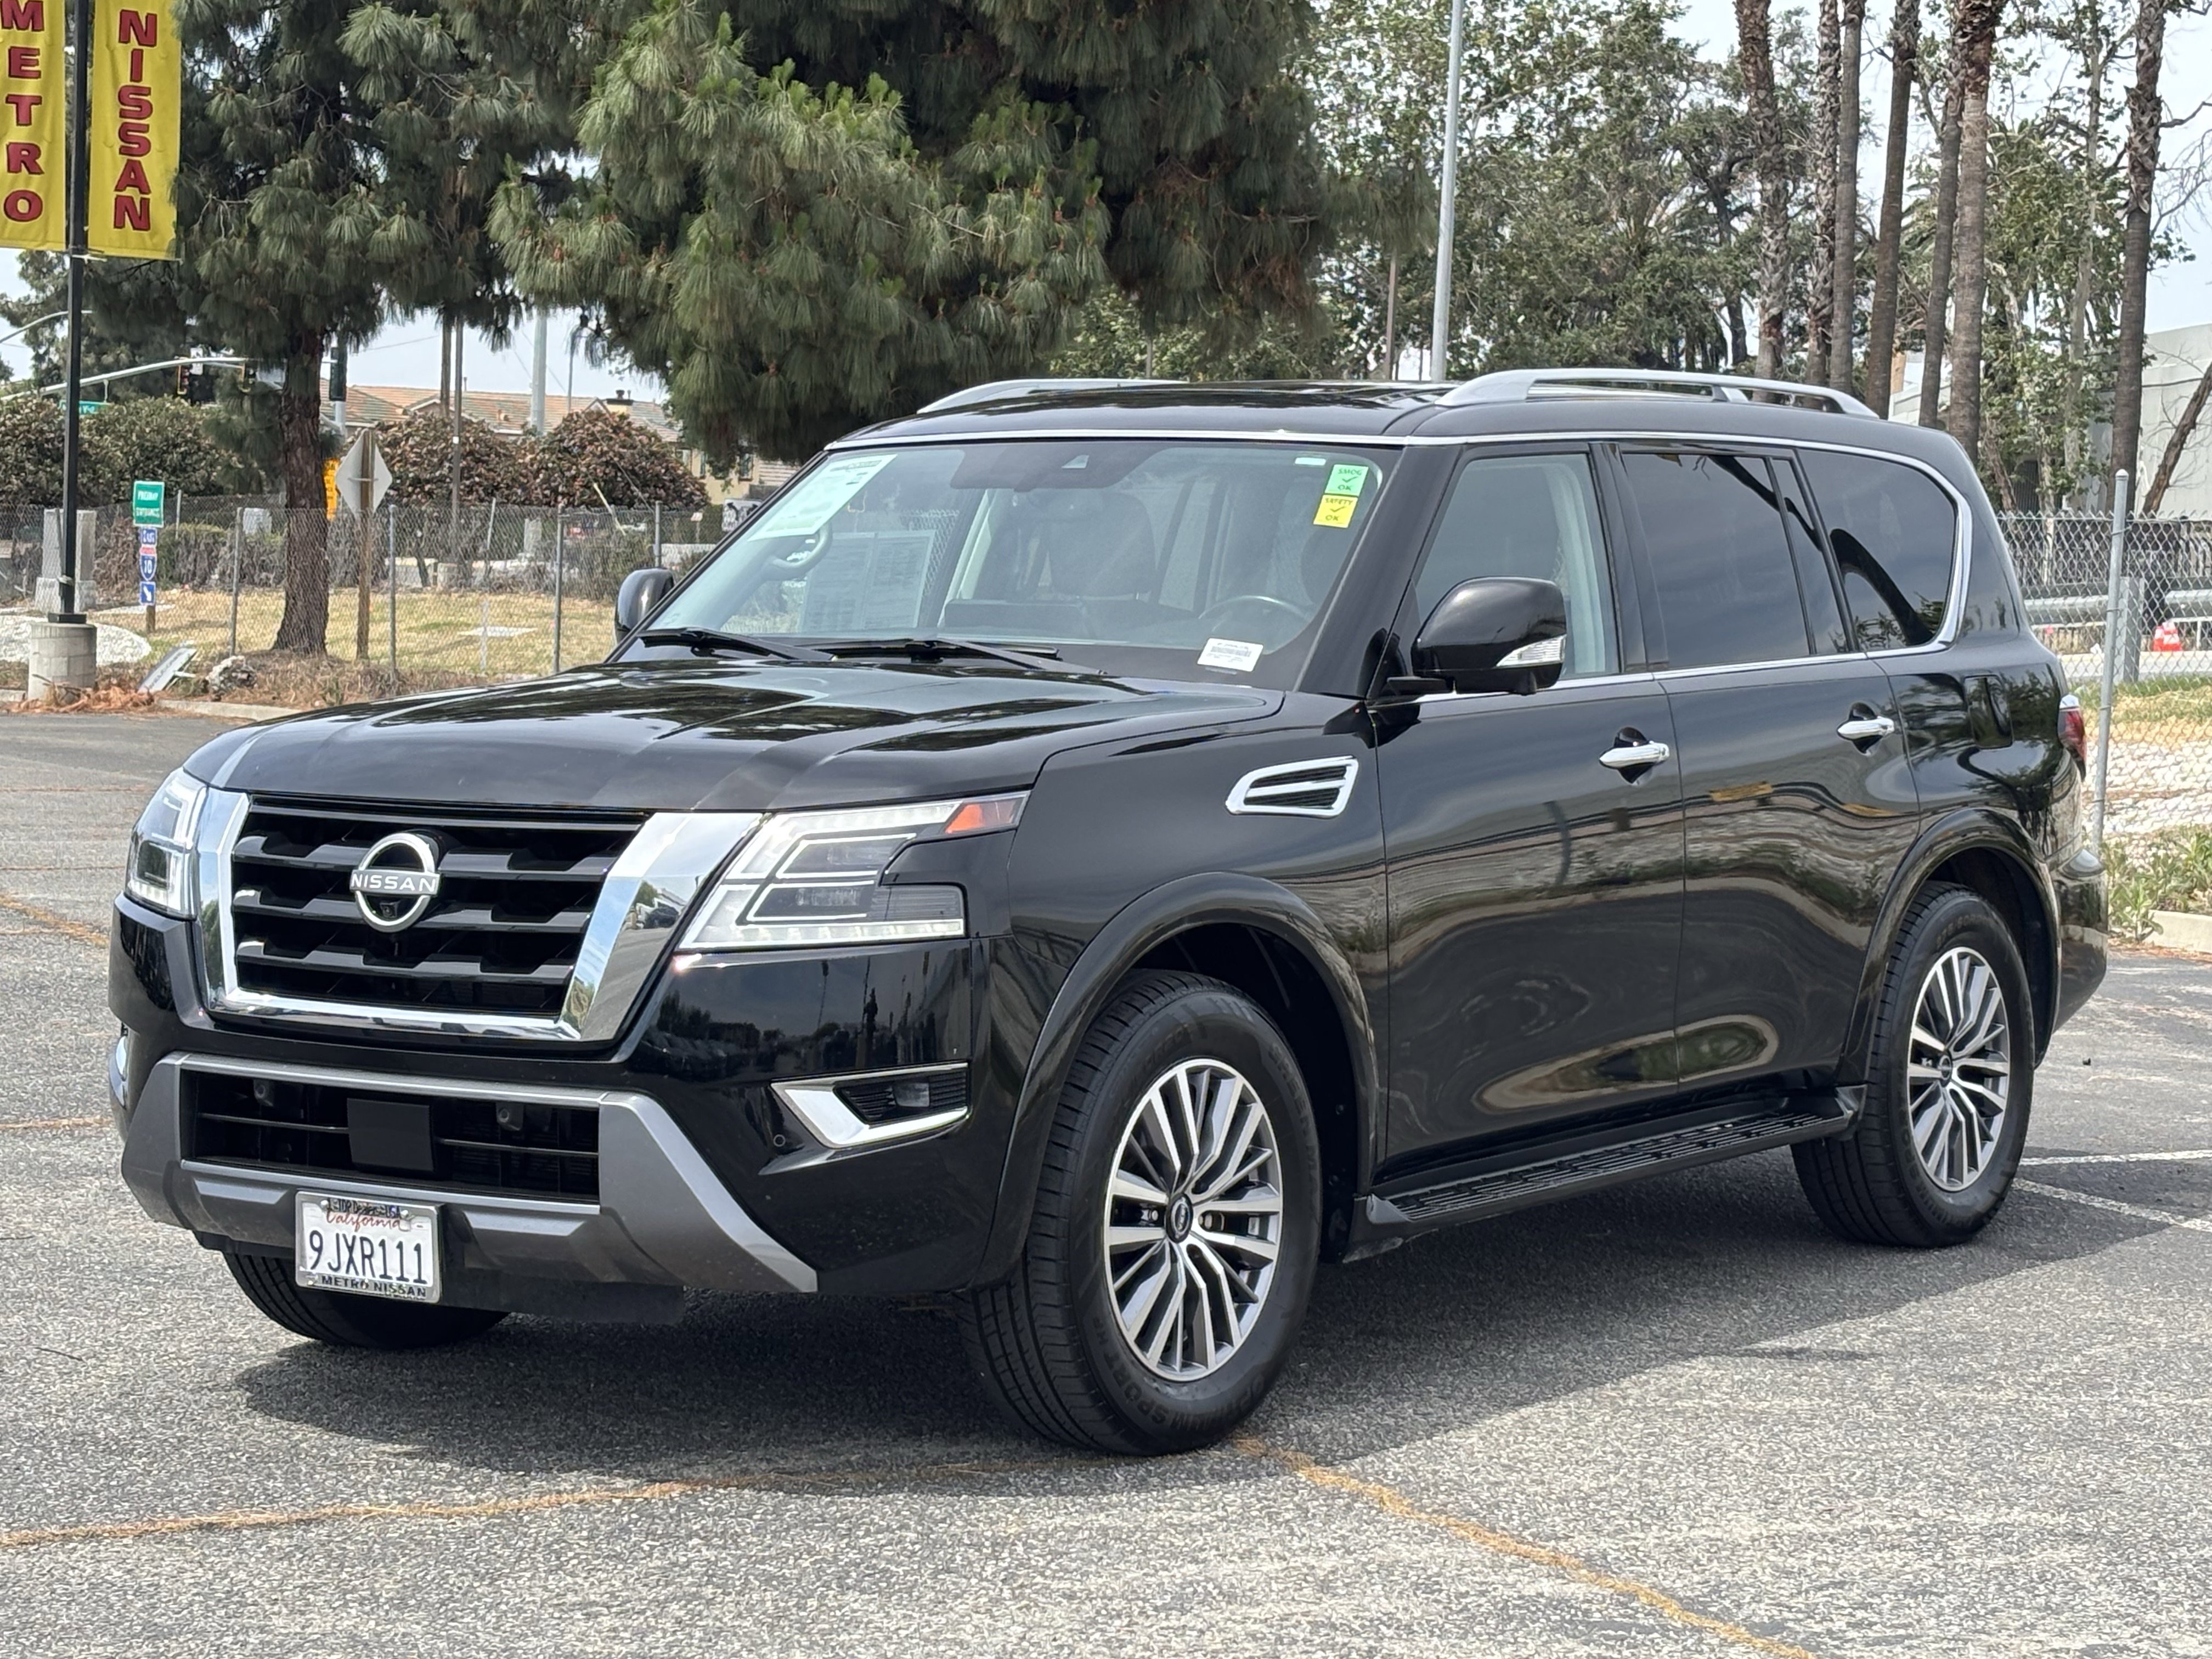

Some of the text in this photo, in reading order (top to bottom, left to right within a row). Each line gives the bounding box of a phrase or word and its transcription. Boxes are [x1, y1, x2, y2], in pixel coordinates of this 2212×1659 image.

[1, 0, 44, 222] METRO
[113, 9, 157, 232] NISSAN
[144, 560, 153, 574] 10
[351, 873, 436, 893] NISSAN
[326, 1210, 405, 1232] California
[309, 1229, 428, 1284] 9JXR111
[321, 1275, 369, 1289] METRO
[374, 1282, 426, 1297] NISSAN
